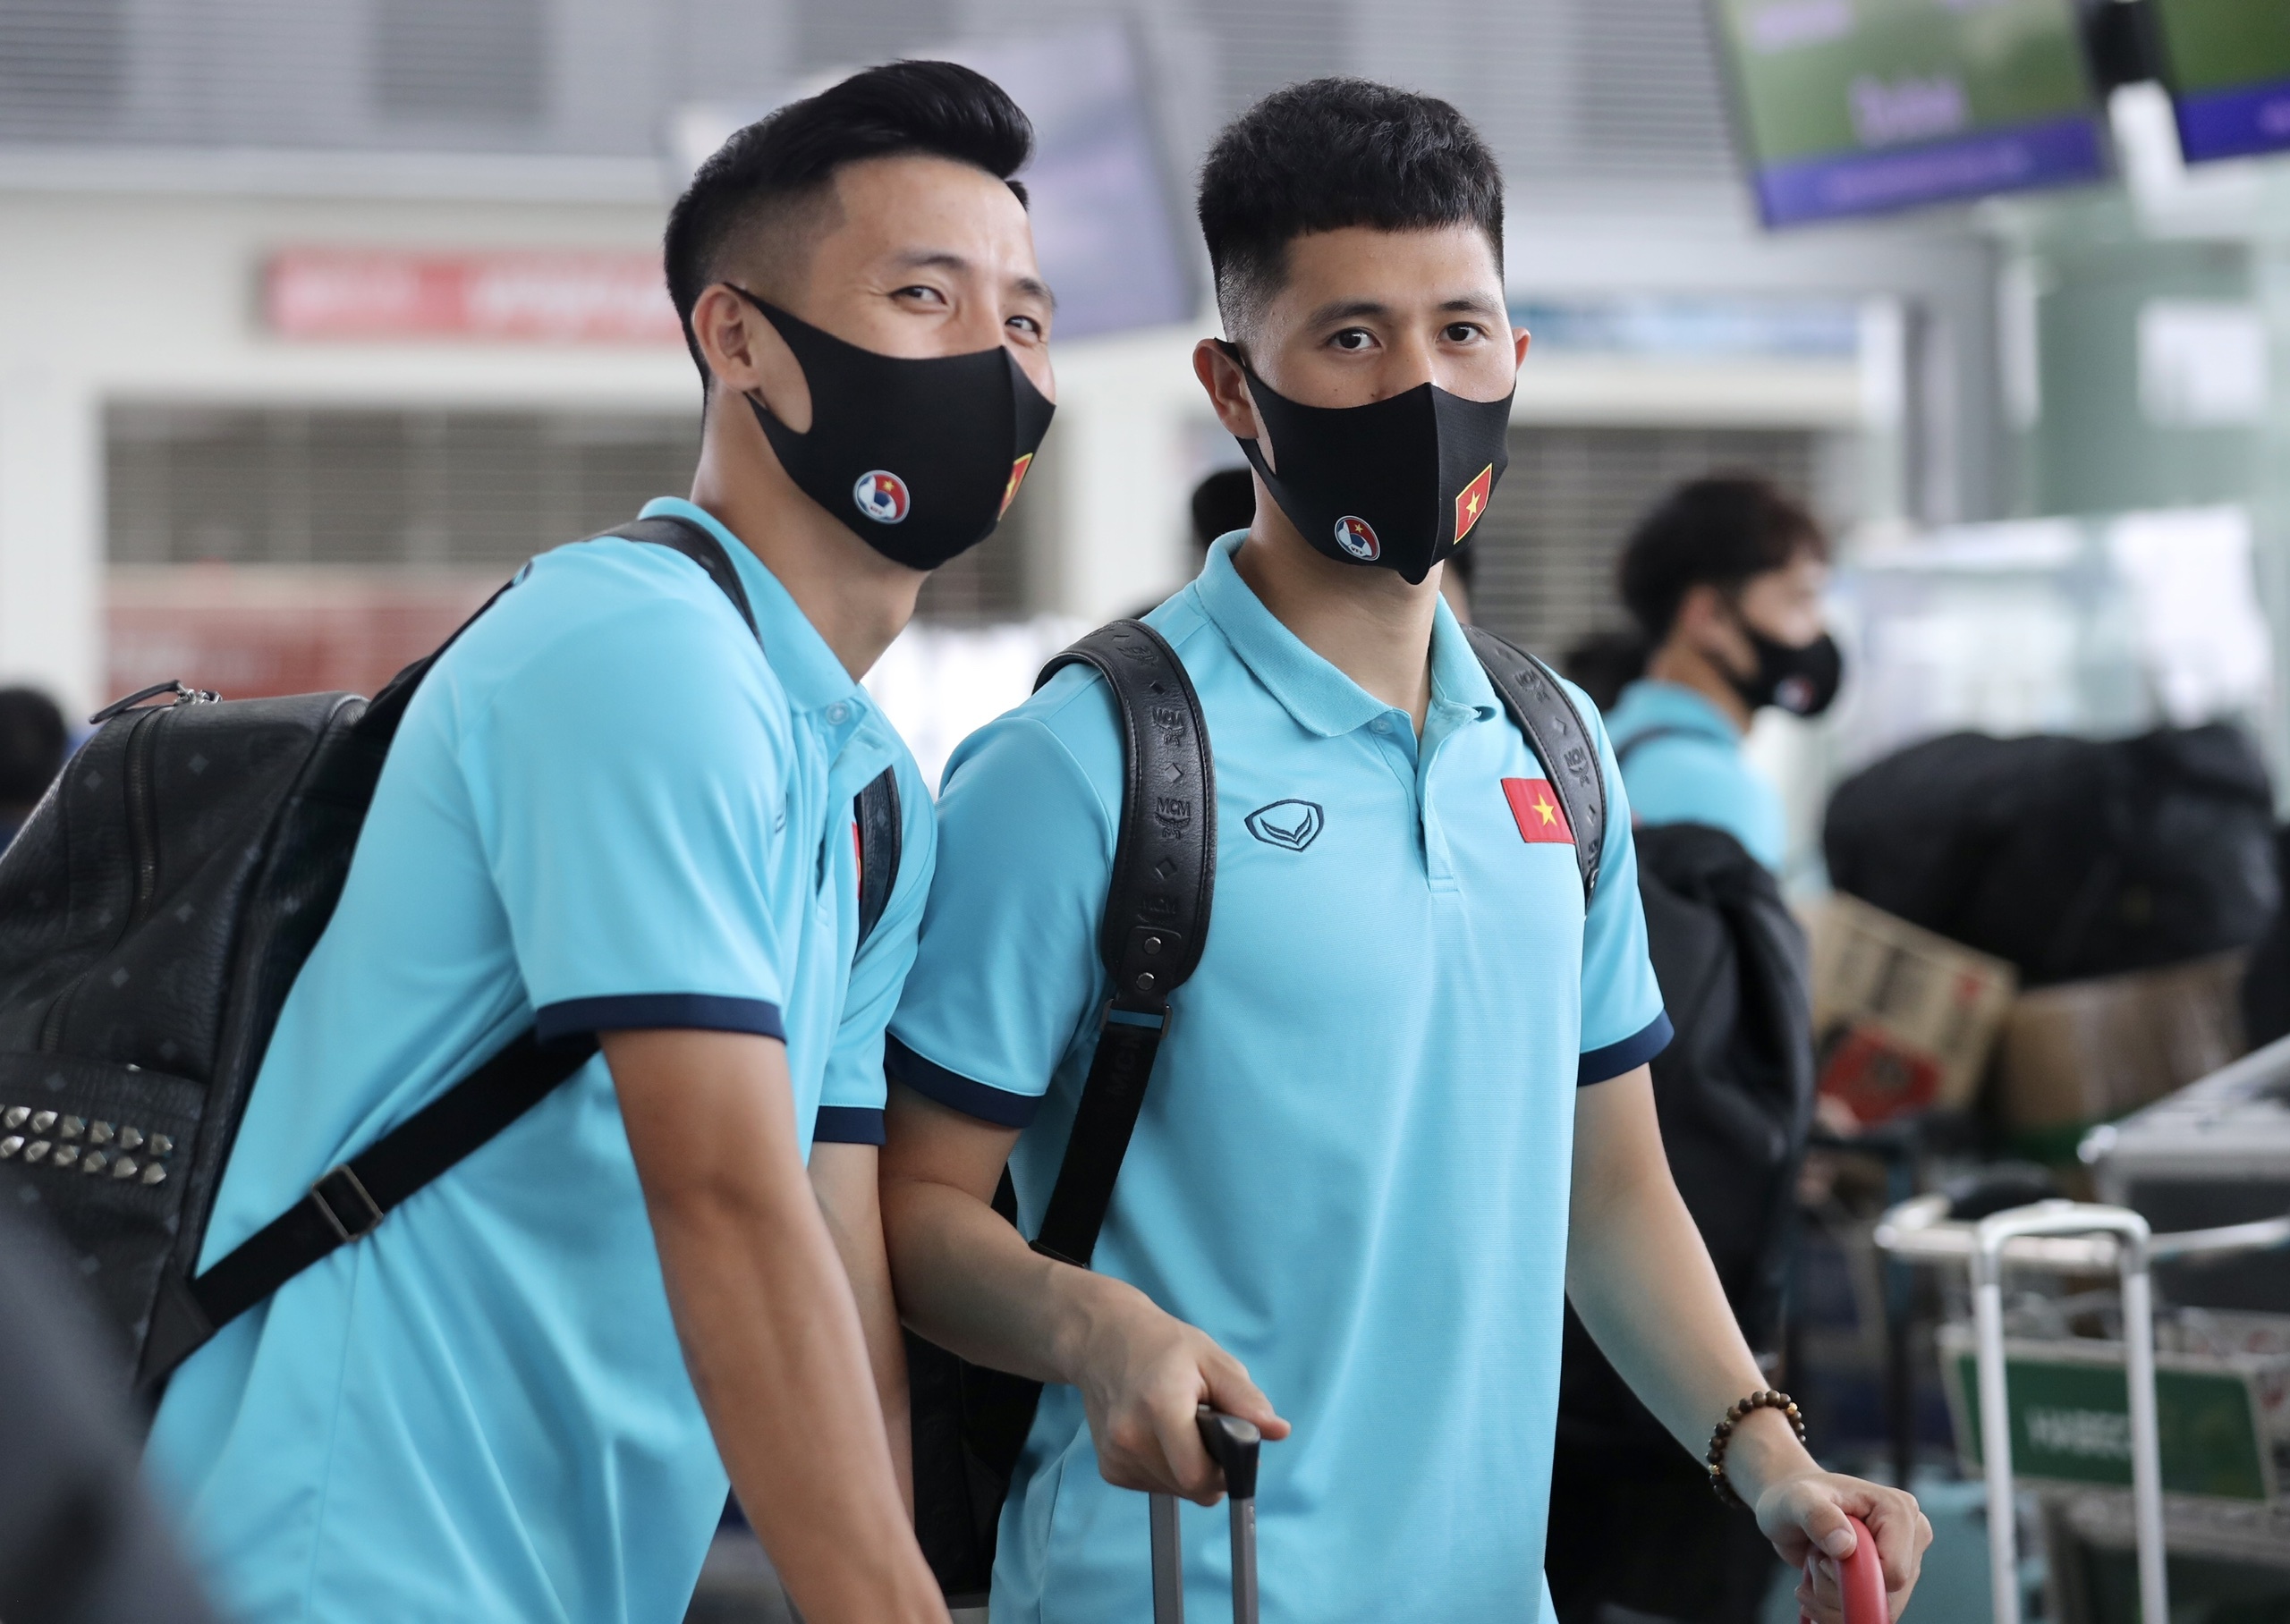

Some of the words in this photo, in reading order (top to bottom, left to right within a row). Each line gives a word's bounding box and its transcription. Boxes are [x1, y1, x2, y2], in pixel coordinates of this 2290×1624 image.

[1150, 706, 1183, 725] MCM
[1564, 746, 1587, 767] MCM
[1157, 797, 1191, 816] MCM
[1141, 895, 1176, 915] MCM
